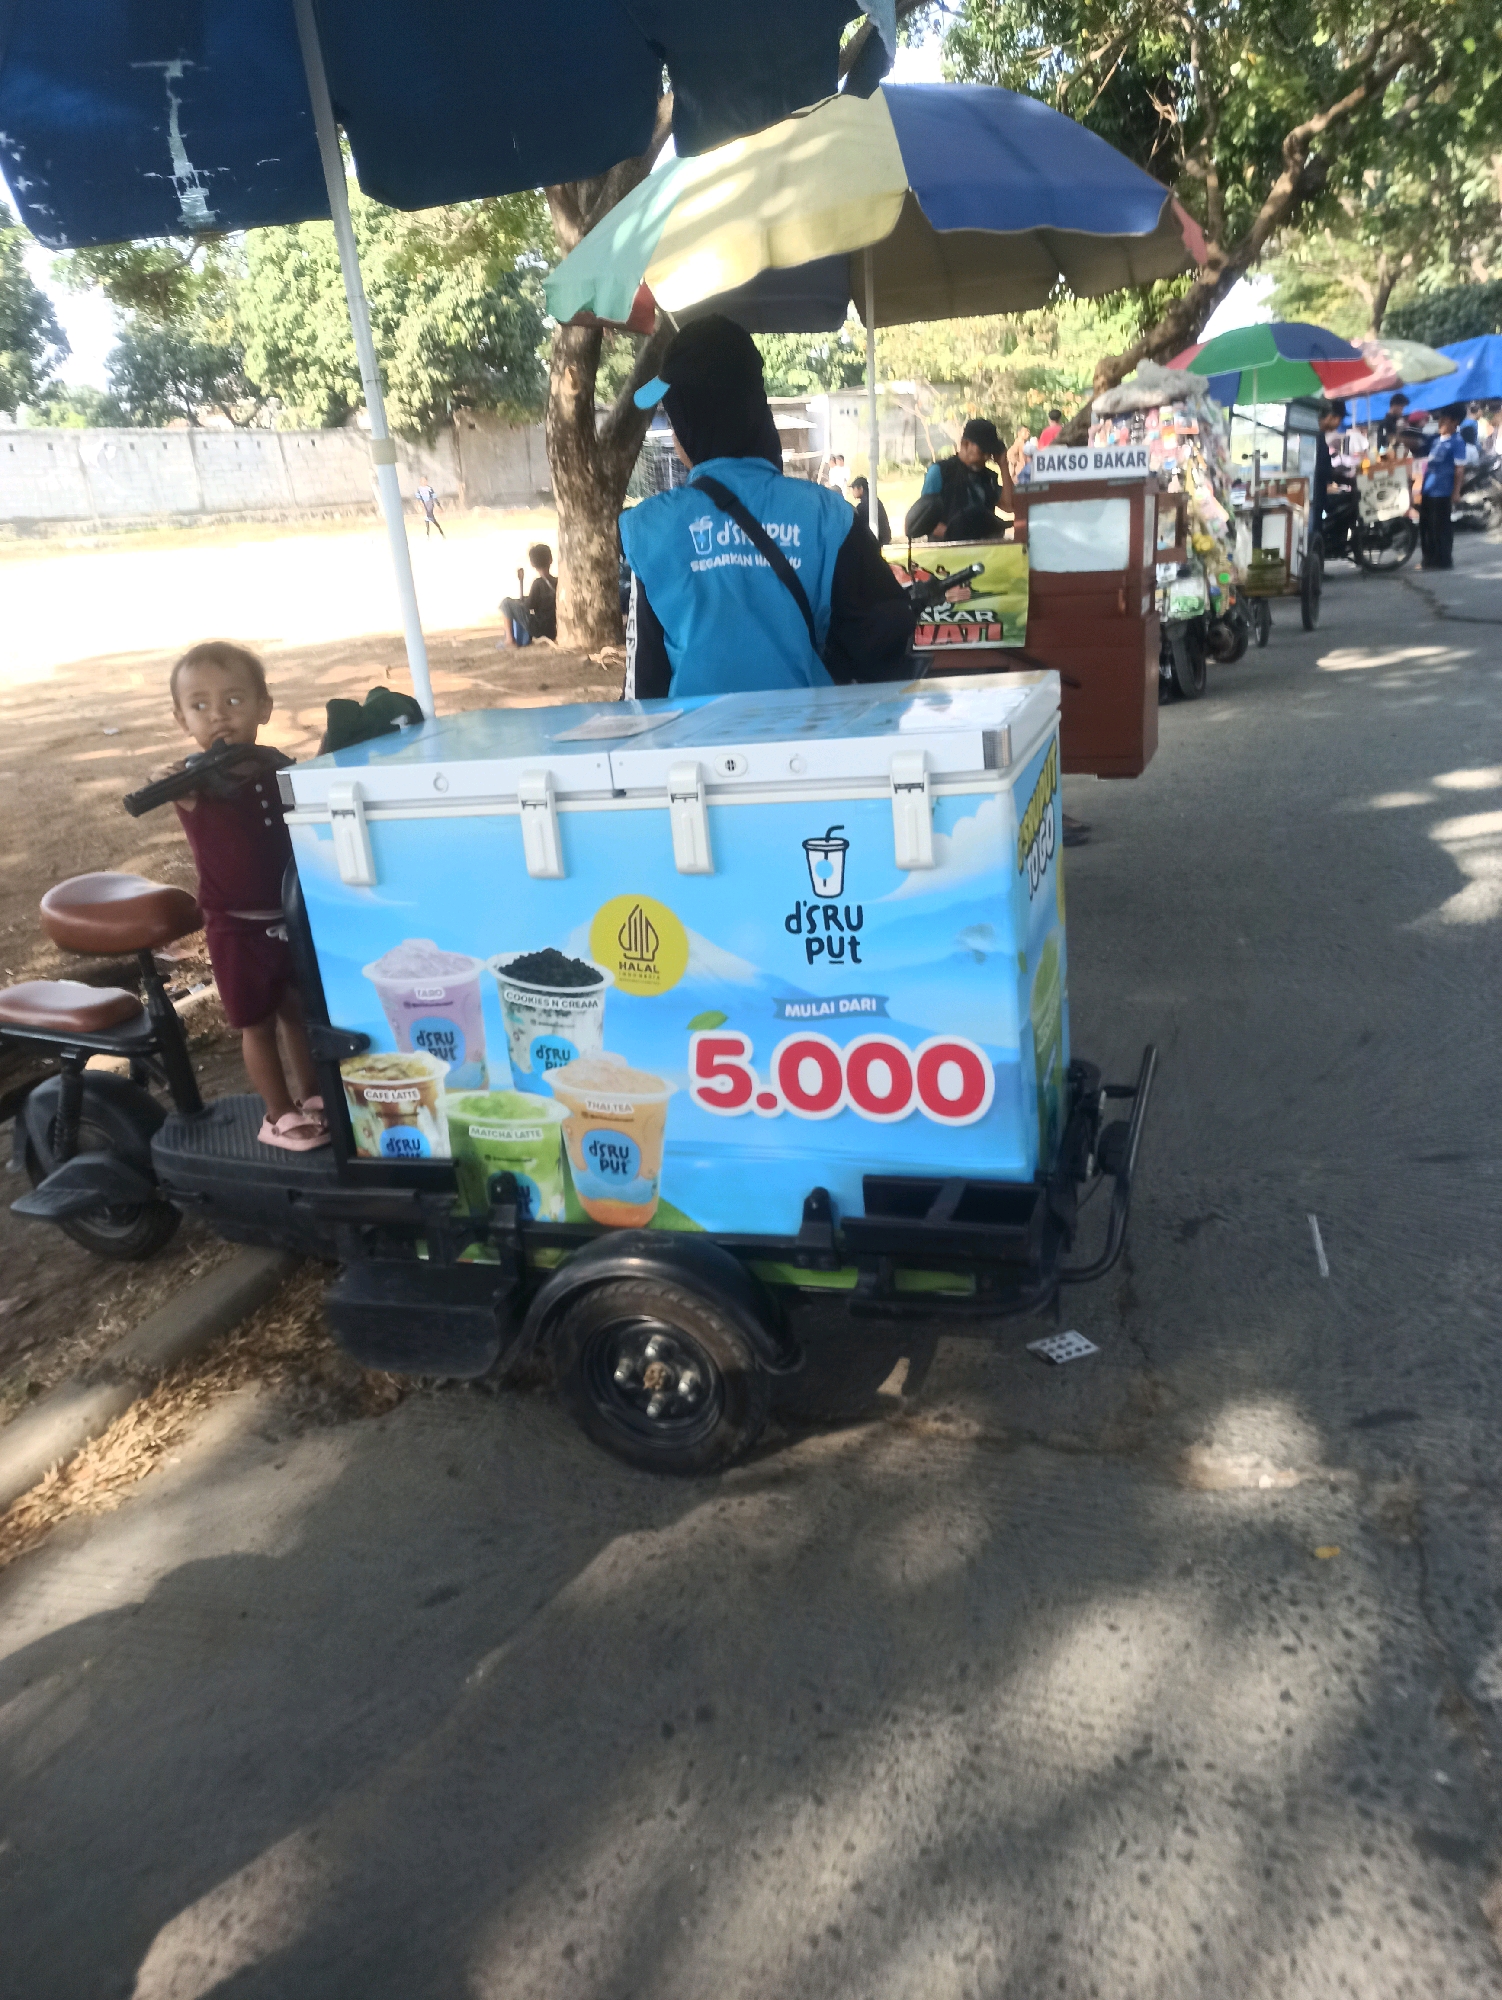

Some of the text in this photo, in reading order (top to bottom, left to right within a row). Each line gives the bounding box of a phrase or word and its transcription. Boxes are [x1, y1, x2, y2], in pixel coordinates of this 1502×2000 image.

[1036, 451, 1147, 472] BAKSO BAKAR
[619, 961, 659, 974] HALAL
[506, 991, 598, 1009] COOKIES N CREAM
[785, 997, 876, 1018] MULAI DARI
[695, 1038, 986, 1118] 5.000
[365, 1090, 418, 1100] CAFE LATTE
[587, 1101, 633, 1113] THAI TEA
[470, 1127, 542, 1139] MATCHA LATTE
